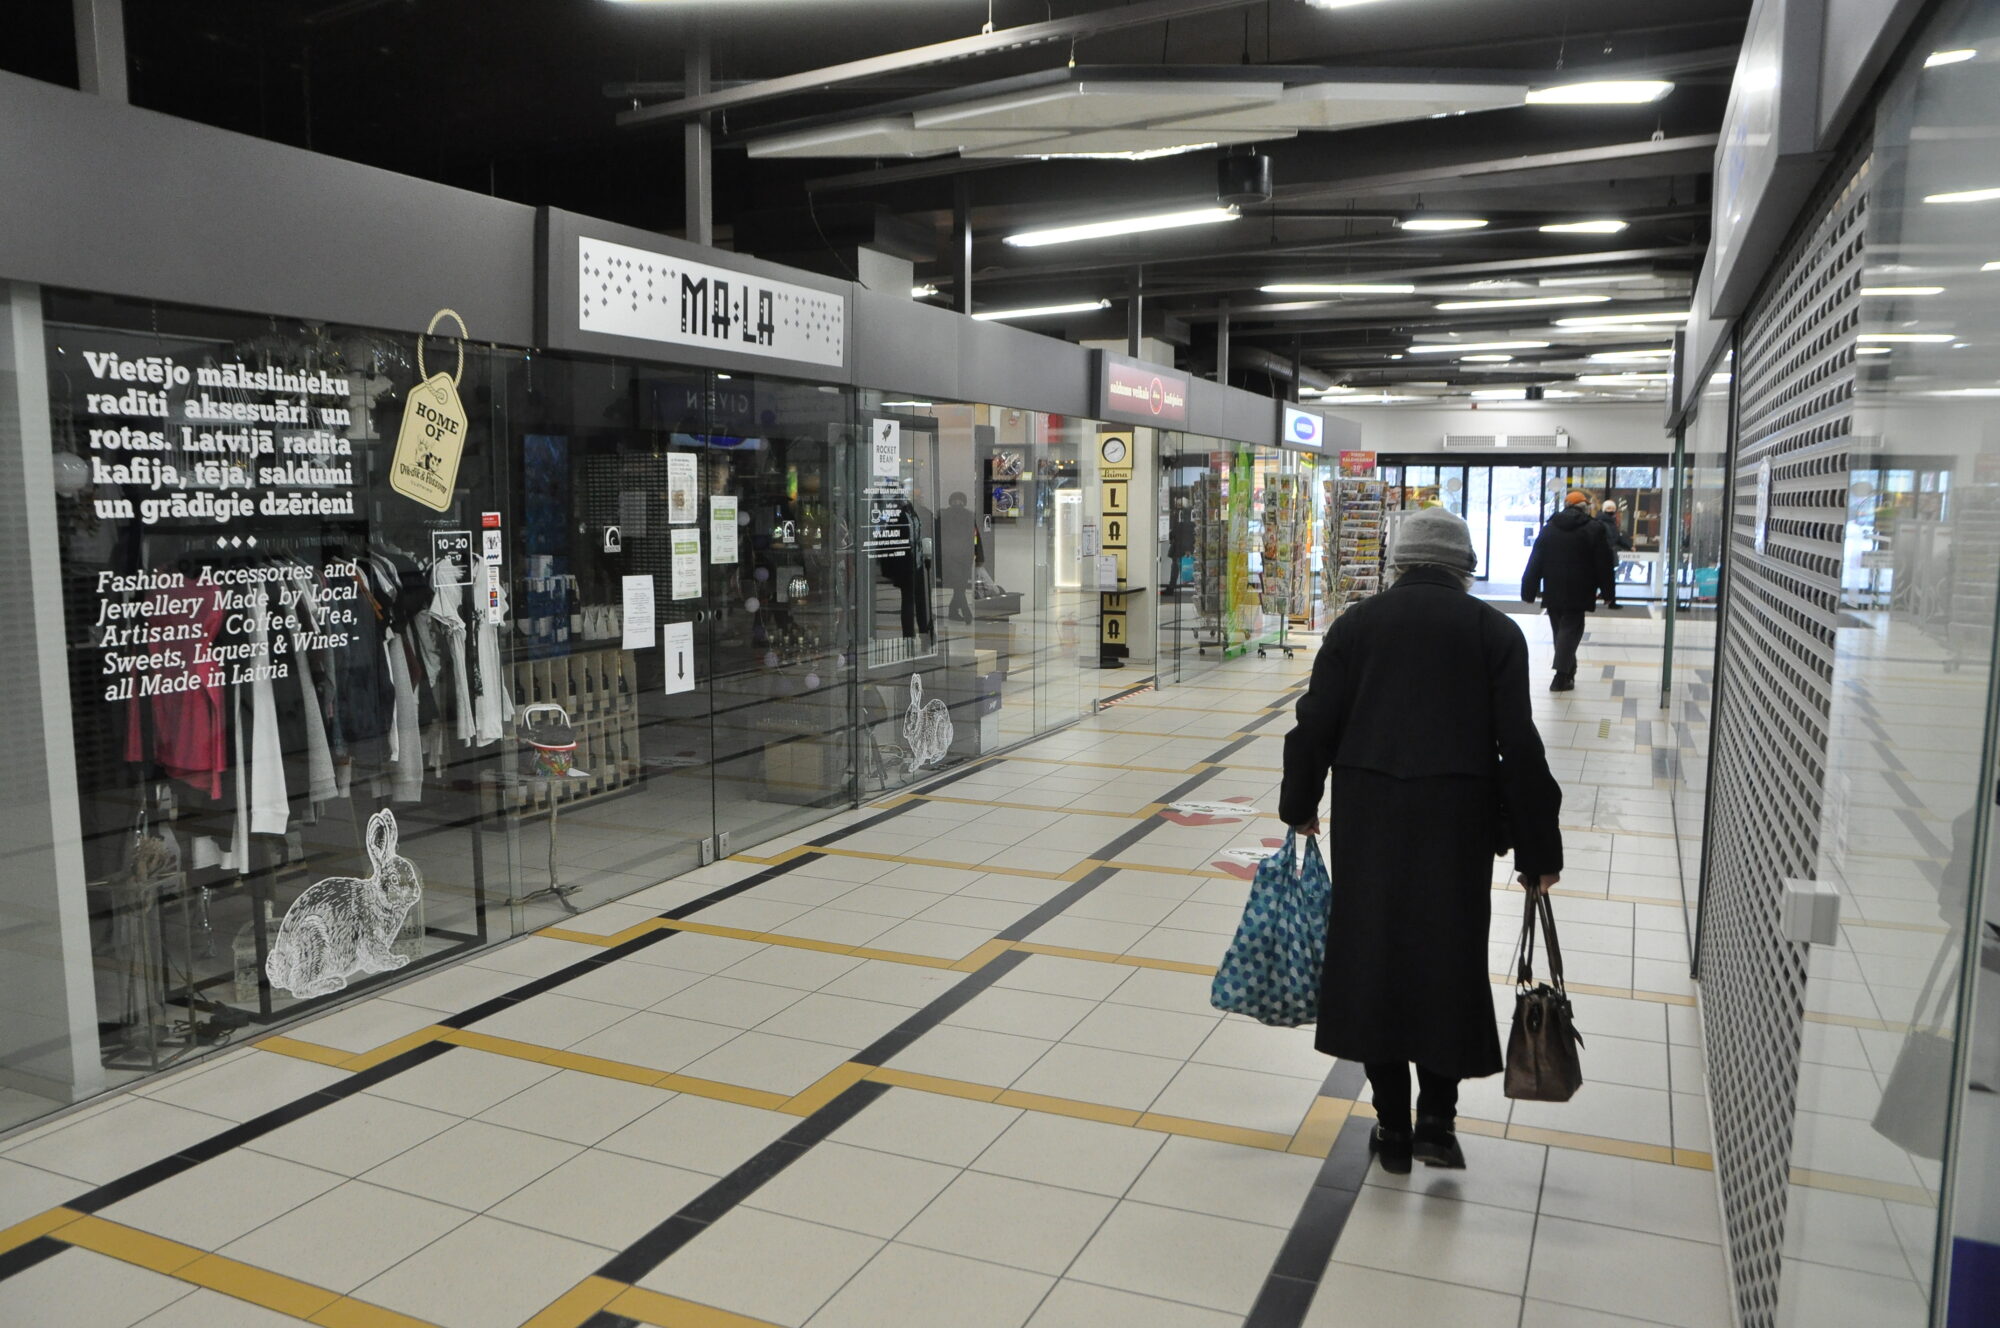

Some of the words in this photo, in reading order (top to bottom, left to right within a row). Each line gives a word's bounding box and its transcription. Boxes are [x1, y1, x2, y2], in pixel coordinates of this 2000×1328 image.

[83, 351, 190, 390] Vietējo
[197, 363, 350, 396] mākslinieku
[87, 388, 169, 417] radīti
[184, 393, 309, 424] aksesuāri
[321, 408, 351, 426] un
[415, 402, 459, 435] HOME
[89, 426, 172, 451] rotas.
[181, 427, 274, 459] Latvijā
[282, 430, 352, 455] radīta
[425, 424, 446, 442] OF
[876, 445, 897, 455] ROCKET
[91, 456, 188, 491] kafija,
[194, 460, 253, 490] tēja,
[259, 460, 353, 485] saldumi
[879, 454, 894, 463] BEAN
[1101, 468, 1128, 478] Laima
[93, 498, 135, 519] un
[140, 491, 255, 524] grādīgie
[259, 491, 354, 516] dzērieni
[96, 569, 185, 593] Fashion
[196, 564, 314, 587] Accessories
[324, 558, 357, 578] and
[95, 594, 205, 627] Jewellery
[212, 588, 269, 611] Made
[279, 585, 303, 610] by
[310, 581, 358, 603] Local
[99, 622, 209, 648] Artisans.
[225, 611, 302, 635] Coffee,
[317, 606, 358, 626] Tea,
[102, 649, 186, 675] Sweets,
[192, 639, 269, 670] Liquers
[273, 636, 288, 655] &
[292, 630, 349, 653] Wines
[104, 678, 134, 702] all
[138, 671, 201, 697] Made
[207, 668, 226, 688] in
[231, 660, 289, 685] Latvia
